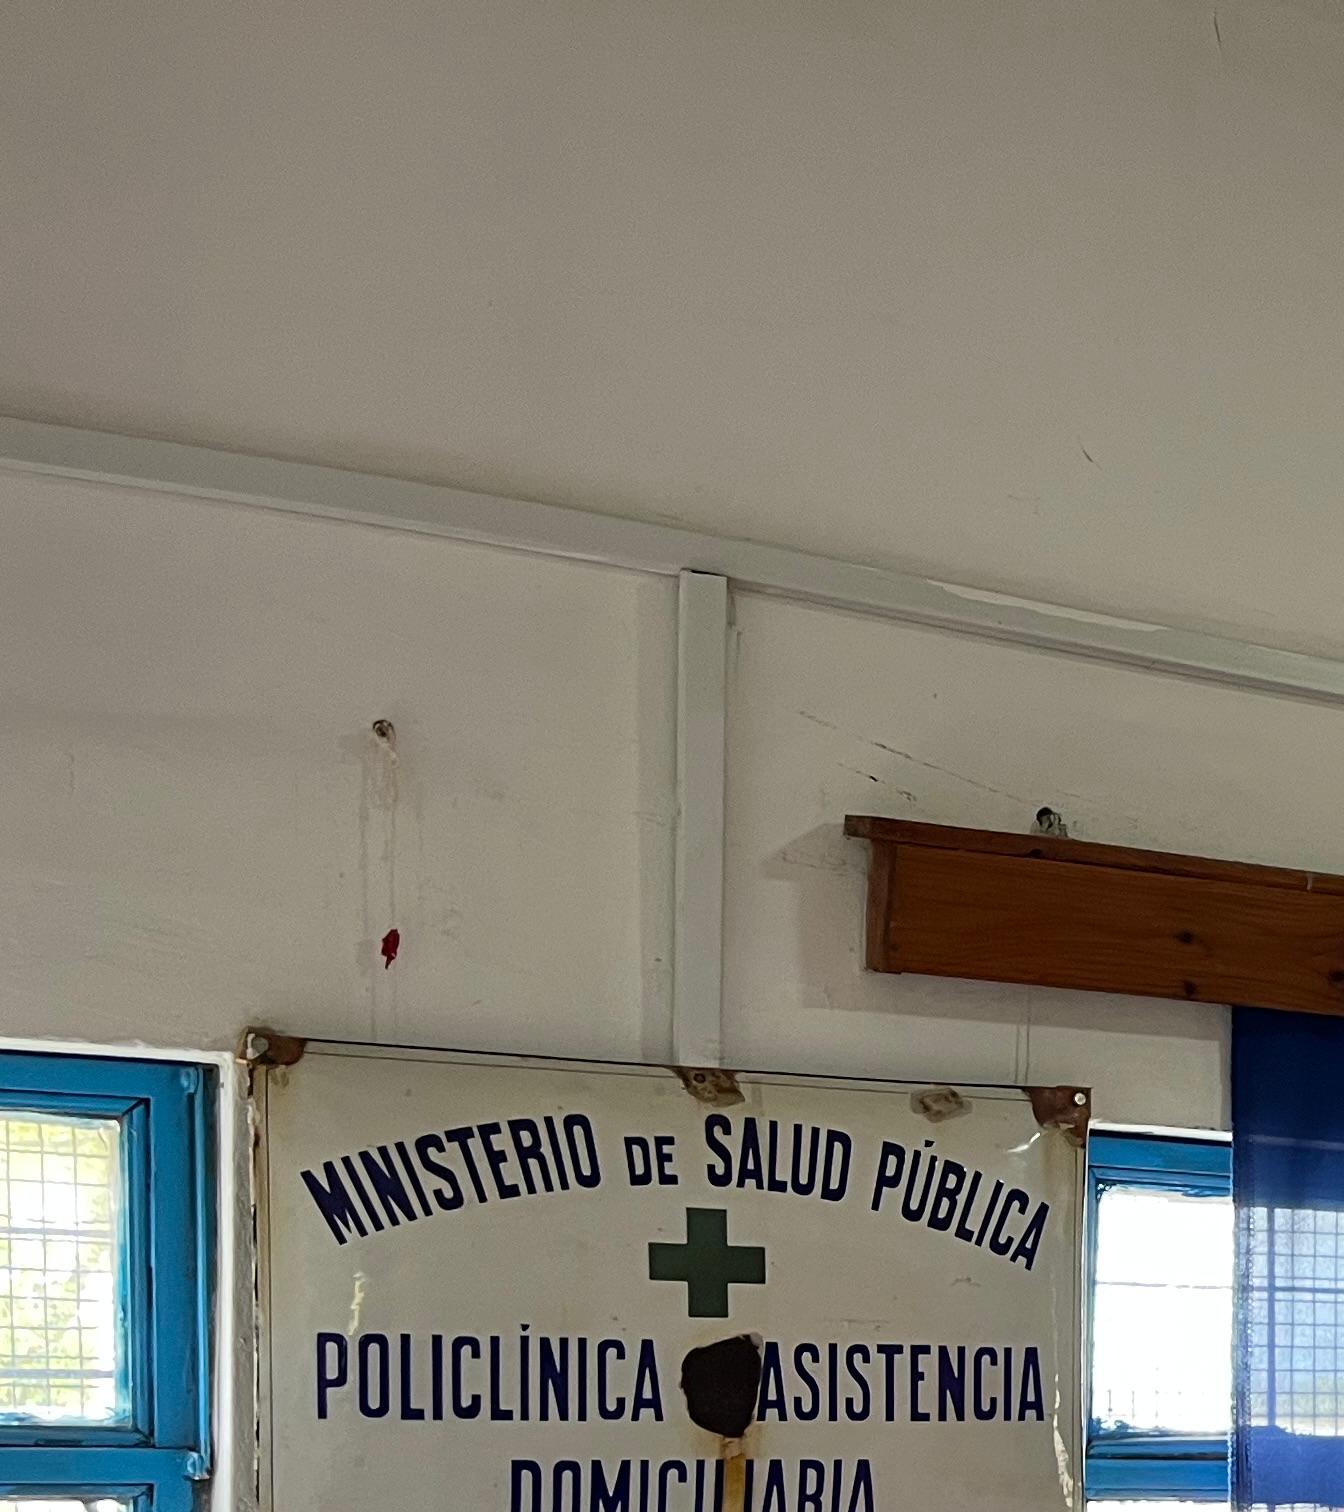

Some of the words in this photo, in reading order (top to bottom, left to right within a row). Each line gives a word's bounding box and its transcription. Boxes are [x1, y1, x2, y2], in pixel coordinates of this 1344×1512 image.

[299, 1112, 602, 1246] MINISTERIO
[624, 1135, 679, 1187] DE
[704, 1113, 853, 1202] SALUD
[870, 1140, 1052, 1272] PÚBLICA
[314, 1323, 665, 1423] POLICLÍNICA
[756, 1341, 1046, 1423] ASISTENCIA
